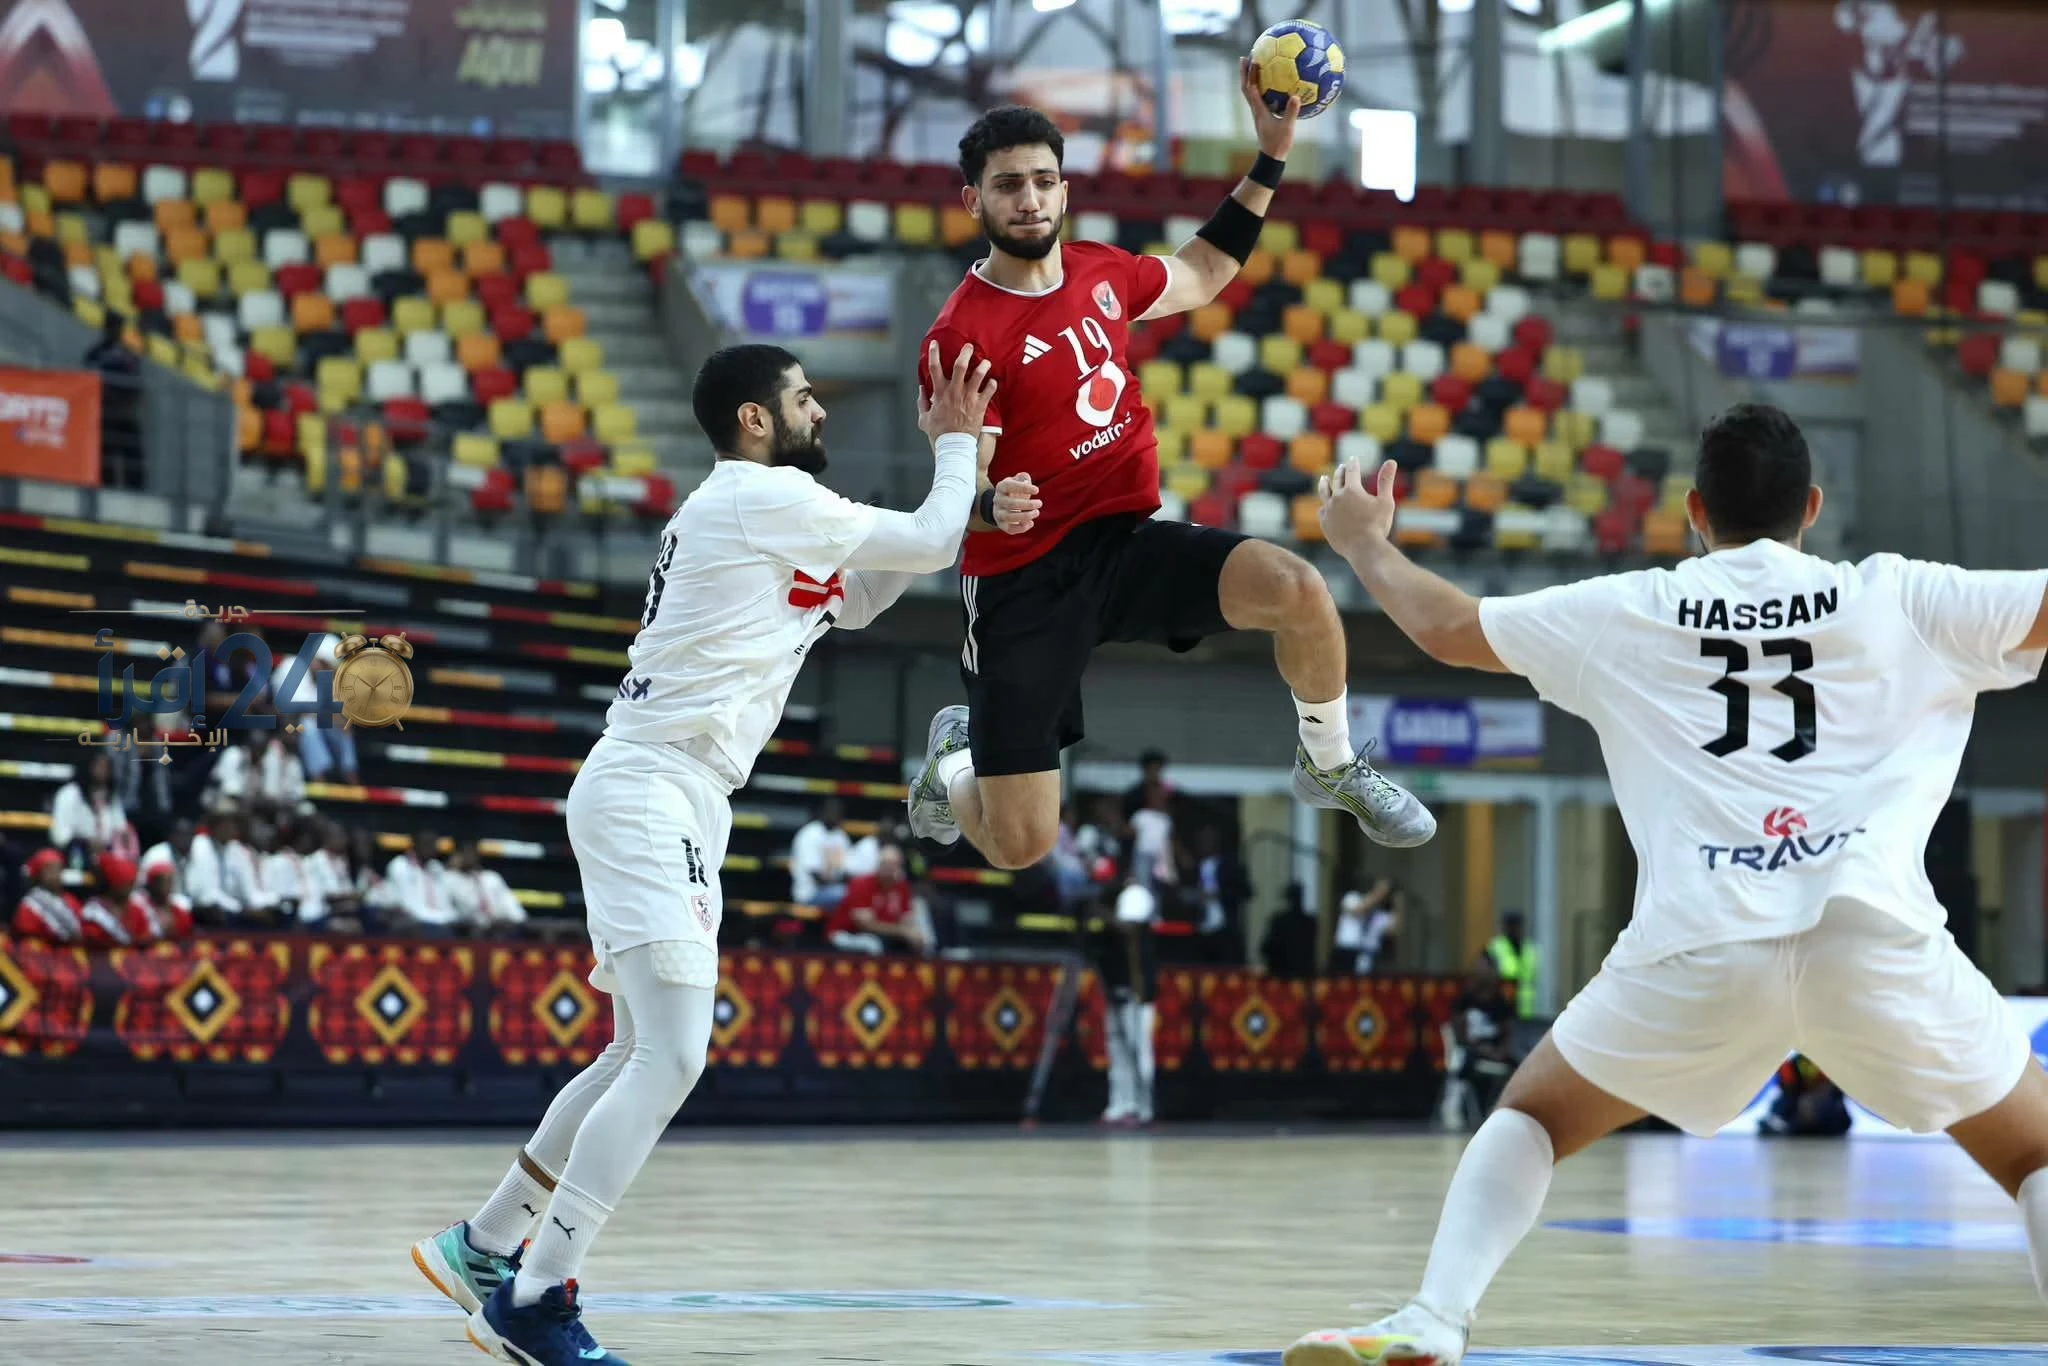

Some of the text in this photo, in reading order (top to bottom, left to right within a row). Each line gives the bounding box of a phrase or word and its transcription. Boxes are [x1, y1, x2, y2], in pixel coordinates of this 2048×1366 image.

[1058, 316, 1112, 380] 19
[1679, 586, 1838, 631] HASSAN
[1700, 637, 1816, 763] 33
